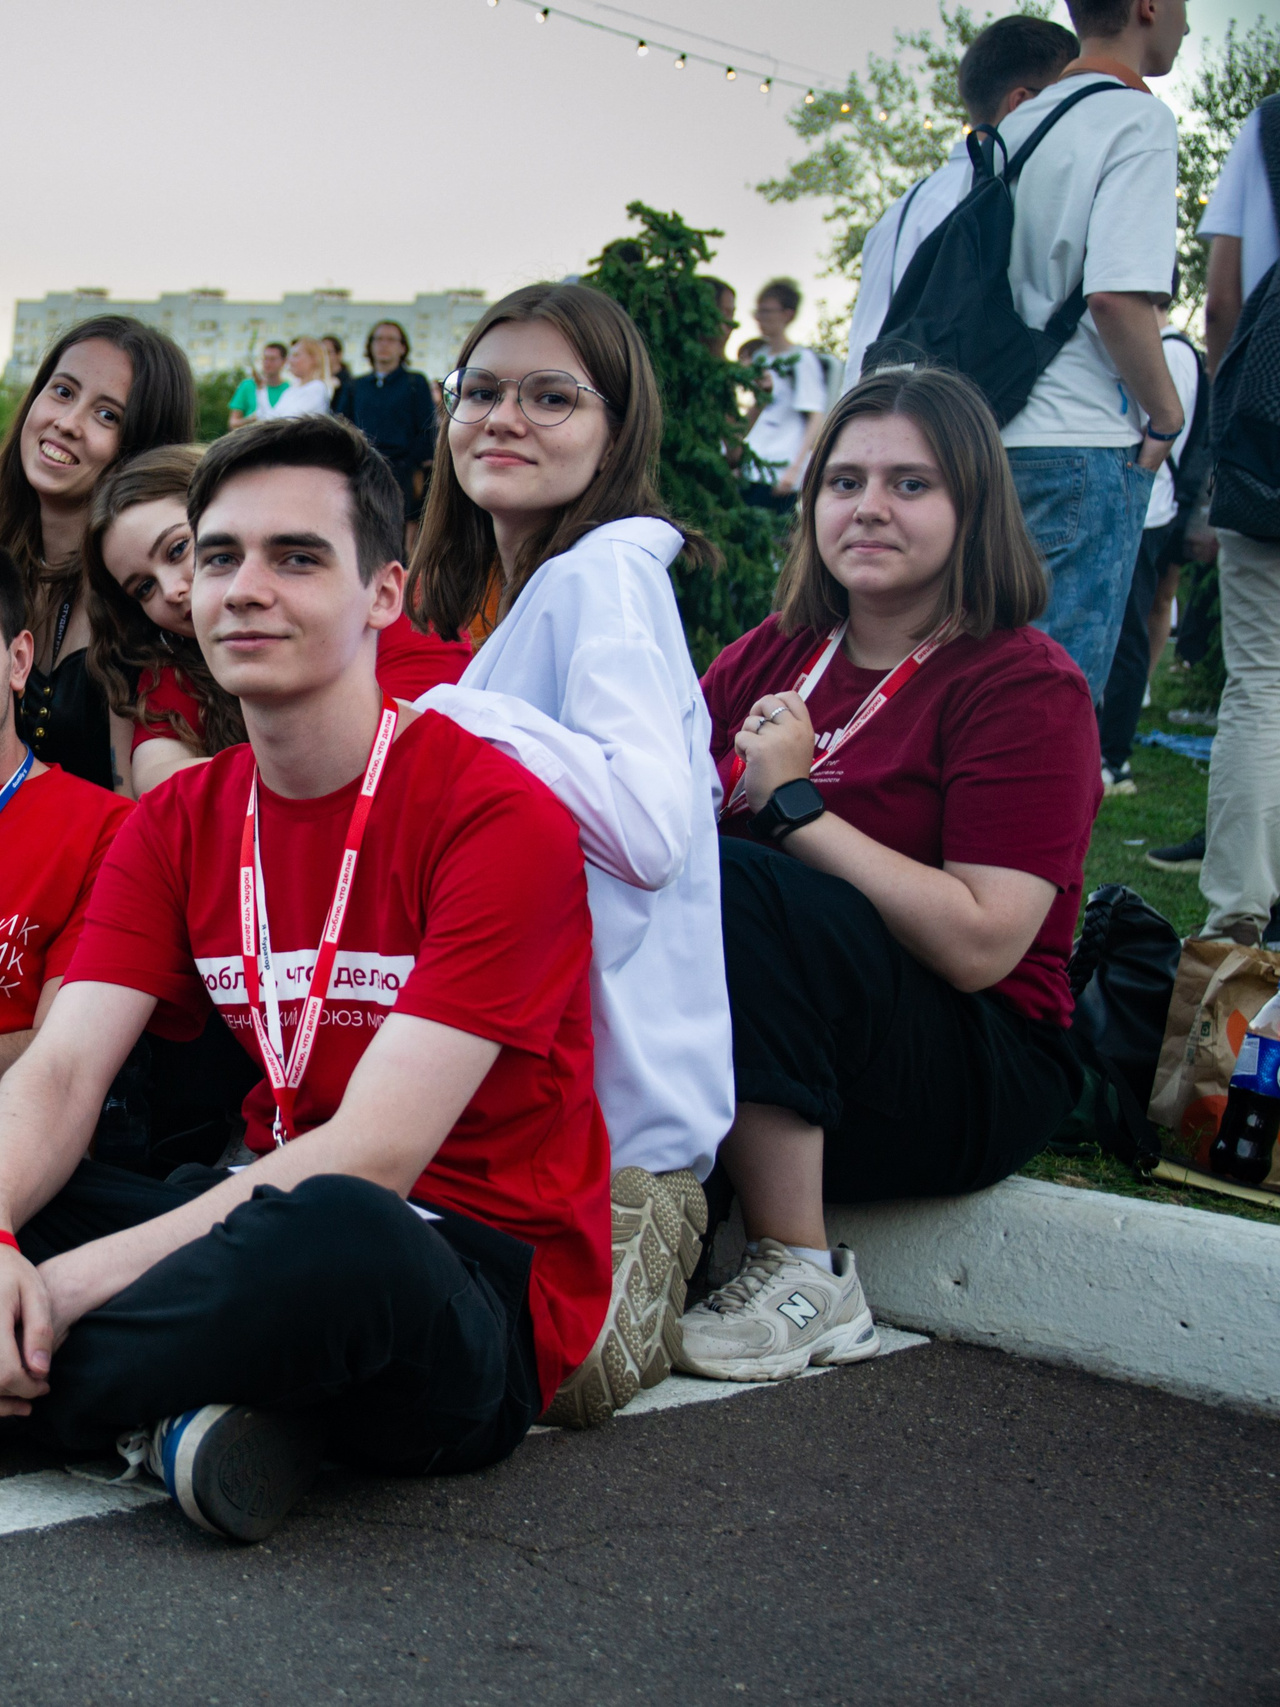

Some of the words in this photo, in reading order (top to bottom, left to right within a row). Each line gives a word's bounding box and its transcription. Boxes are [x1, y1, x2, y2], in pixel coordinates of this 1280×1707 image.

[58, 603, 69, 640] СТУДЕНТ
[366, 758, 381, 791] люблю,
[377, 741, 385, 755] что
[382, 713, 392, 740] делаю
[330, 904, 343, 938] люблю,
[338, 886, 346, 902] что
[343, 854, 353, 884] делаю
[261, 936, 271, 970] Куратор
[319, 1009, 363, 1027] ОЮЗ
[292, 1052, 307, 1084] люблю,
[302, 1033, 310, 1048] что
[307, 1001, 318, 1031] делаю
[268, 1056, 281, 1084] делаю
[777, 1291, 819, 1330] N
